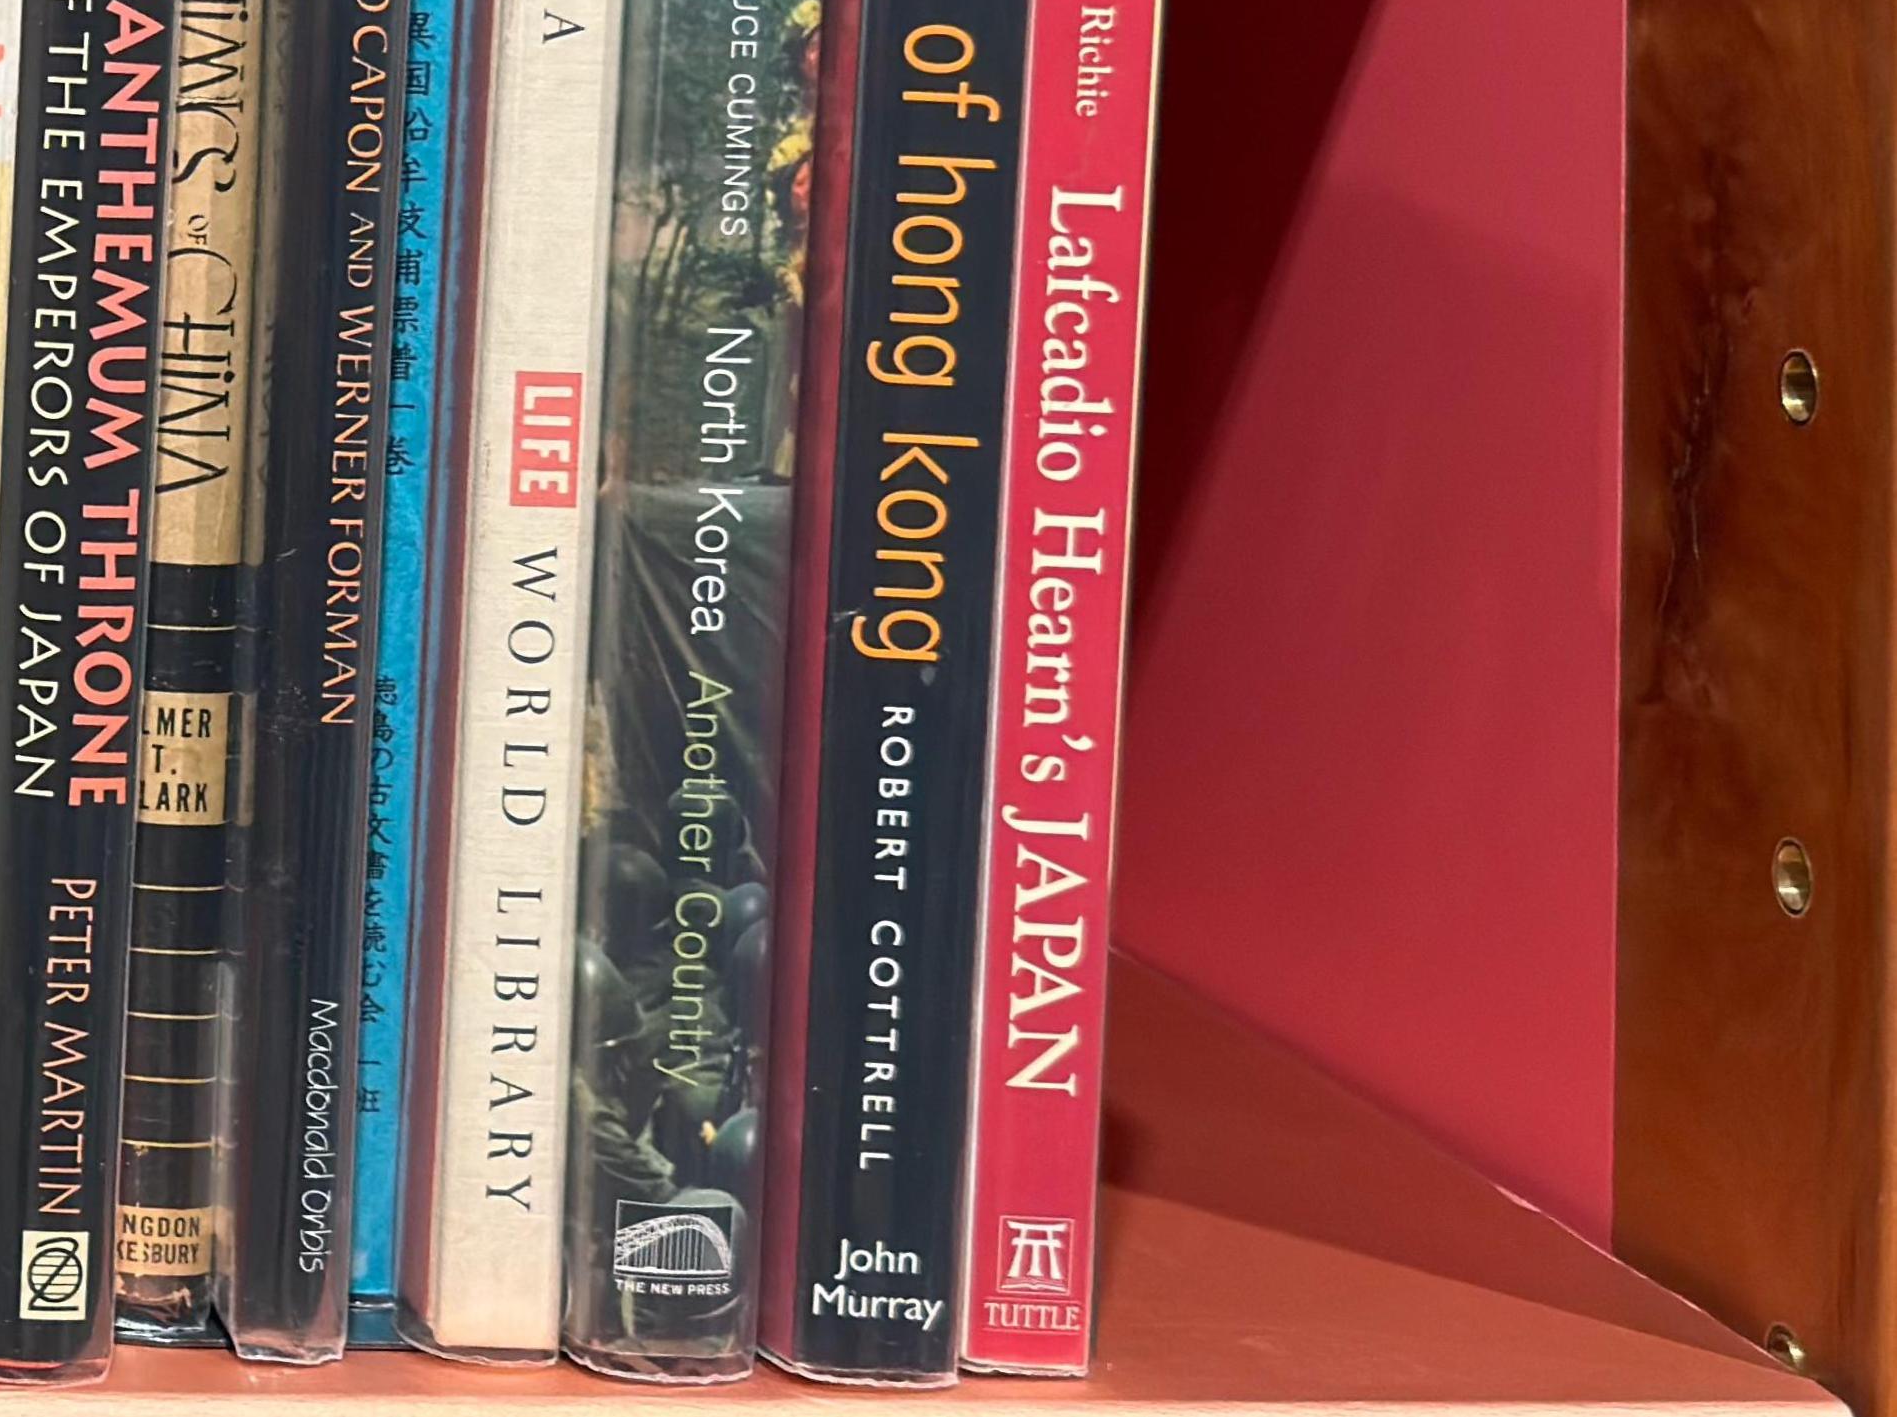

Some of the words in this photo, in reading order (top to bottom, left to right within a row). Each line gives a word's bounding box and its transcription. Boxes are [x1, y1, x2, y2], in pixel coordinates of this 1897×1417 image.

[43, 32, 90, 151] THE
[346, 24, 390, 193] CAPON
[902, 24, 1002, 123] of
[1075, 4, 1117, 118] Richie
[718, 75, 757, 236] CUMINGS
[27, 178, 83, 486] EMPERORS
[866, 152, 997, 387] hong
[1036, 184, 1126, 483] Lafcadio
[330, 305, 376, 504] WERNER
[518, 385, 574, 494] LIFE
[699, 327, 752, 464] North
[22, 510, 67, 586] OF
[320, 516, 364, 725] FORMAN
[690, 486, 744, 635] Korea
[851, 432, 982, 663] kong
[14, 603, 63, 798] JAPAN
[68, 489, 140, 807] THRONE
[501, 546, 559, 826] WORLD
[678, 671, 733, 873] Another
[874, 705, 915, 891] ROBERT
[44, 877, 97, 1006] PETER
[653, 892, 723, 1087] Country
[1002, 804, 1089, 1097] JAPAN
[37, 1021, 91, 1216] MARTIN
[303, 998, 339, 1179] Macdonald
[485, 887, 543, 1212] LIBRARY
[859, 920, 906, 1170] COTTRELL
[650, 1283, 683, 1295] NEW
[688, 1283, 732, 1295] PRESS
[811, 1283, 943, 1332] Murray
[834, 1239, 920, 1279] John
[984, 1301, 1080, 1331] TUTTLE
